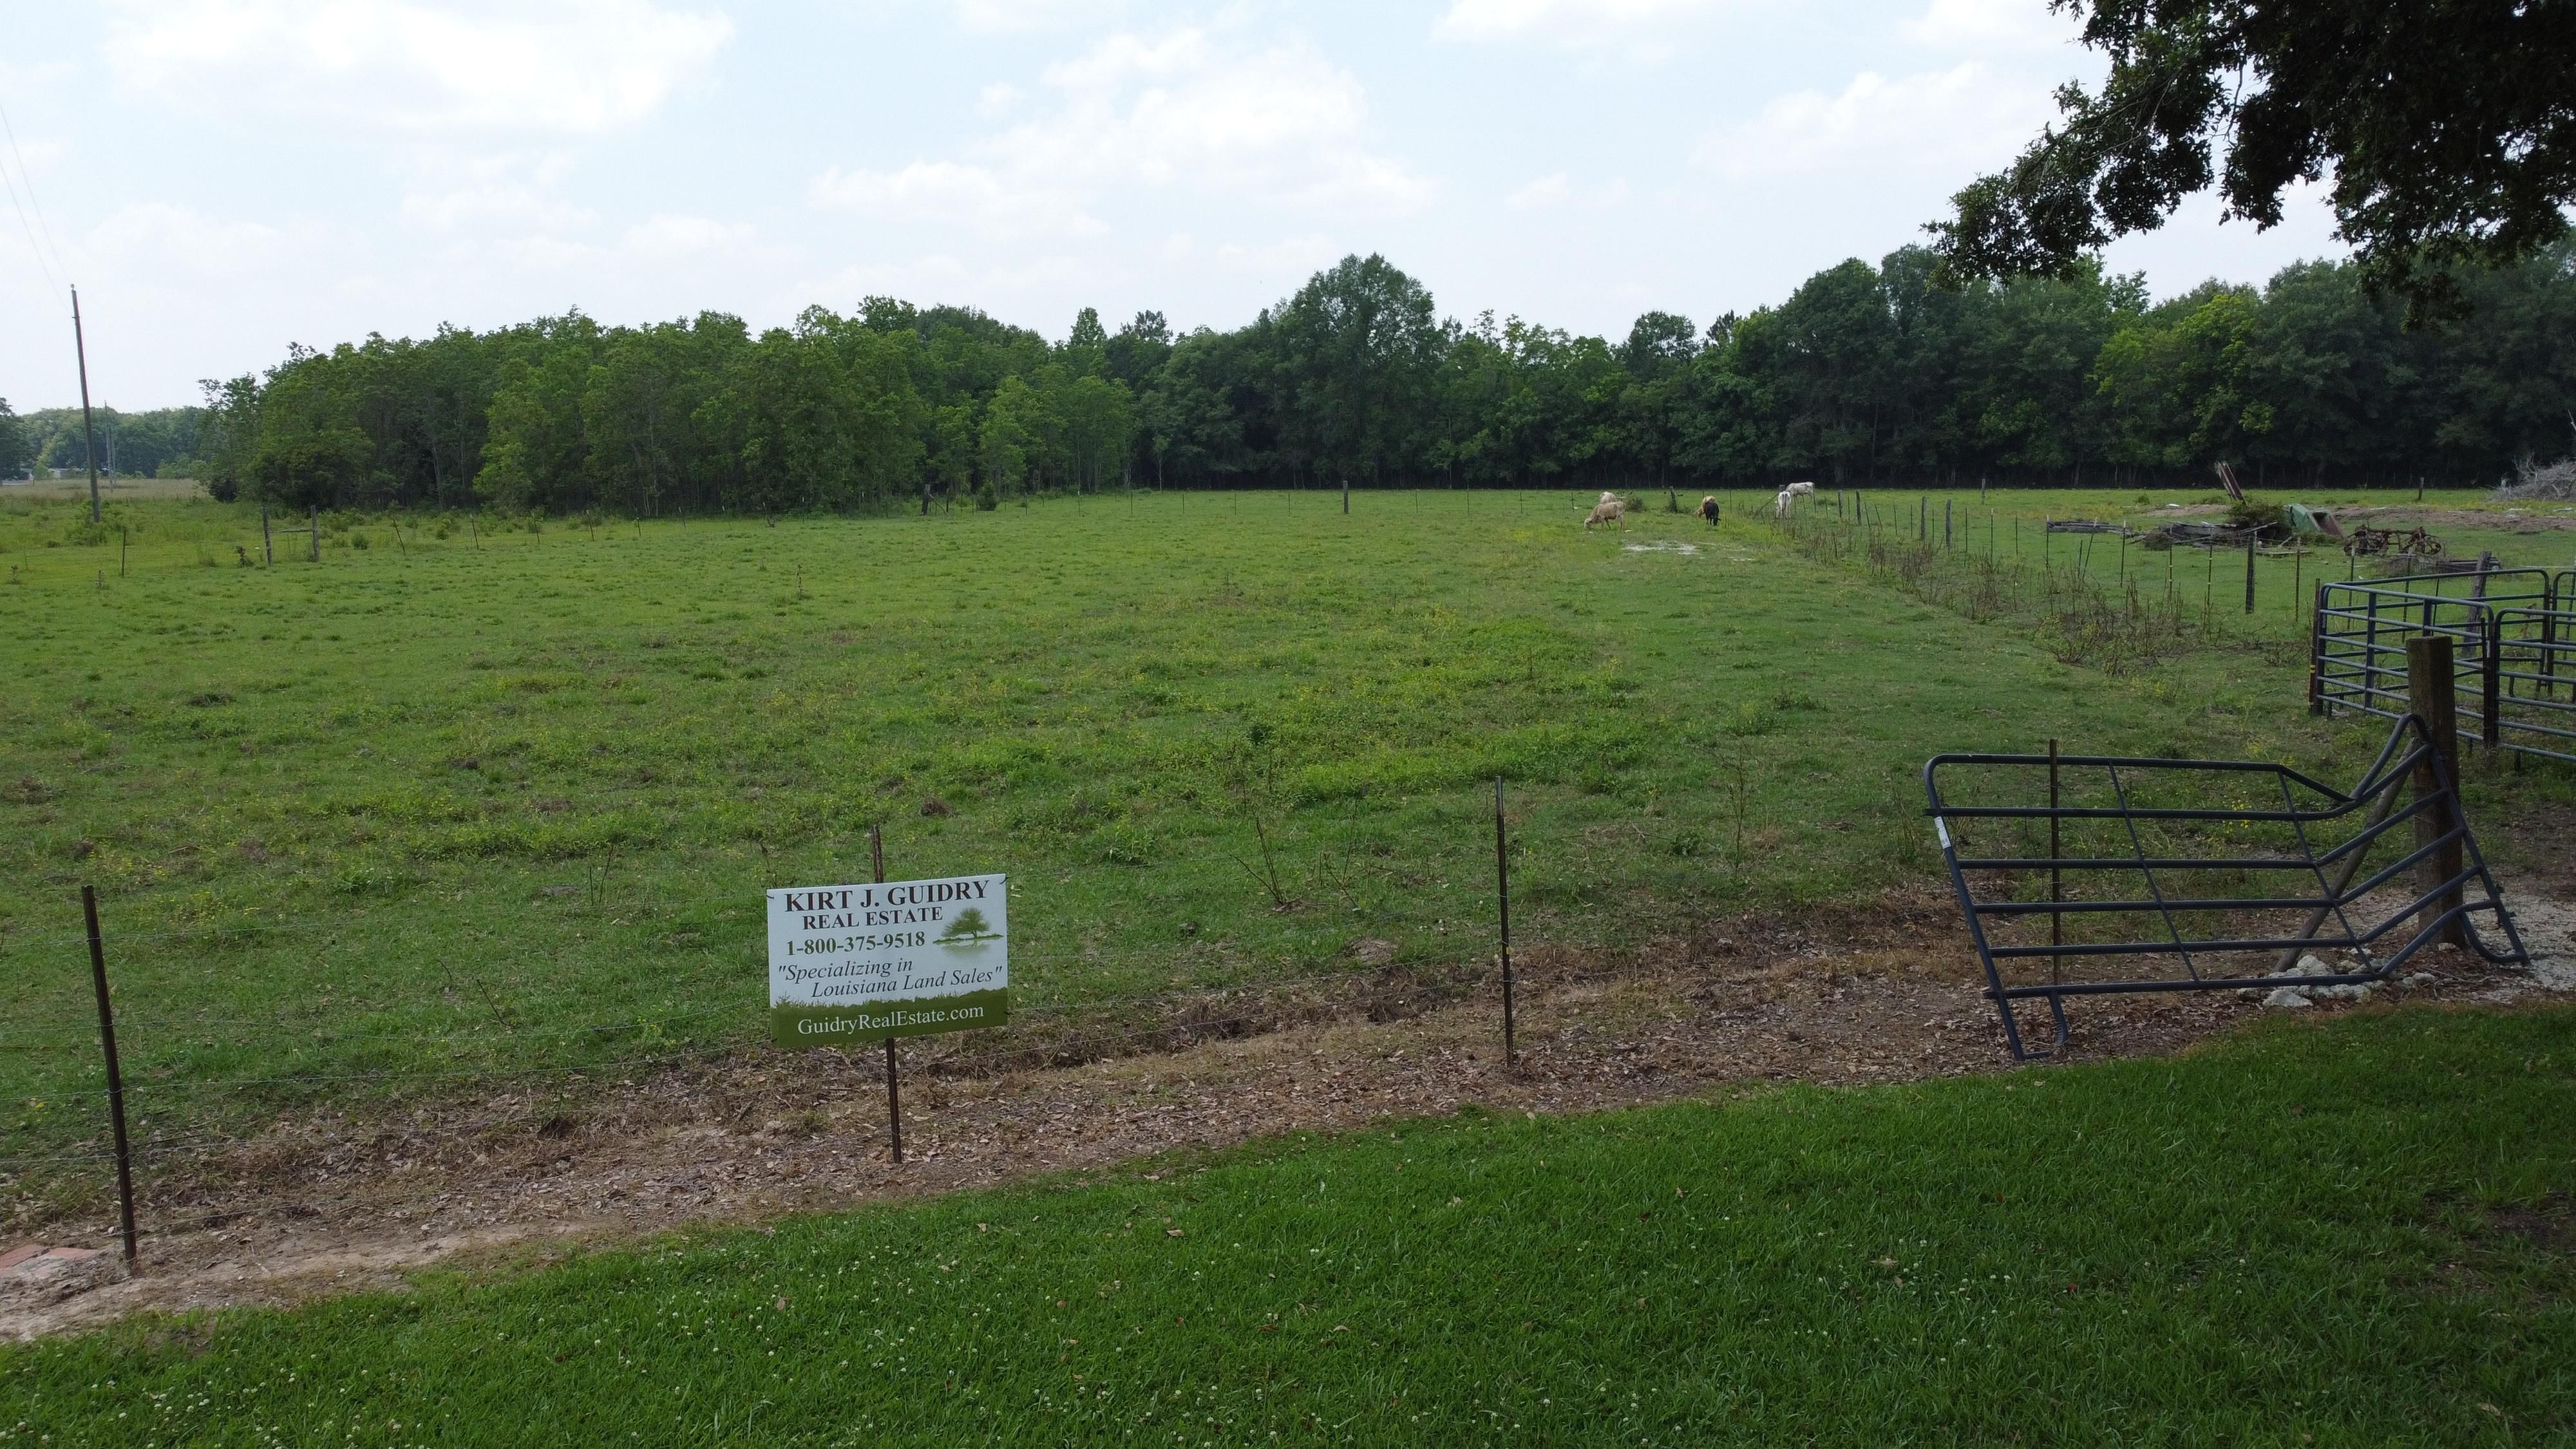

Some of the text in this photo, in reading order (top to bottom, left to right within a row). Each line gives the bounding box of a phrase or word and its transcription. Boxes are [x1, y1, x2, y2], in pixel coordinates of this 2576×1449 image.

[784, 880, 990, 912] KIRT J. GUIDRY
[802, 907, 943, 930] REAL ESTATE
[787, 931, 925, 956] 1-800-375-9518
[778, 958, 913, 984] "Specializing in
[811, 965, 1003, 998] Louisiana Land Sales"
[798, 1005, 984, 1035] GuidryRealEstate.com
